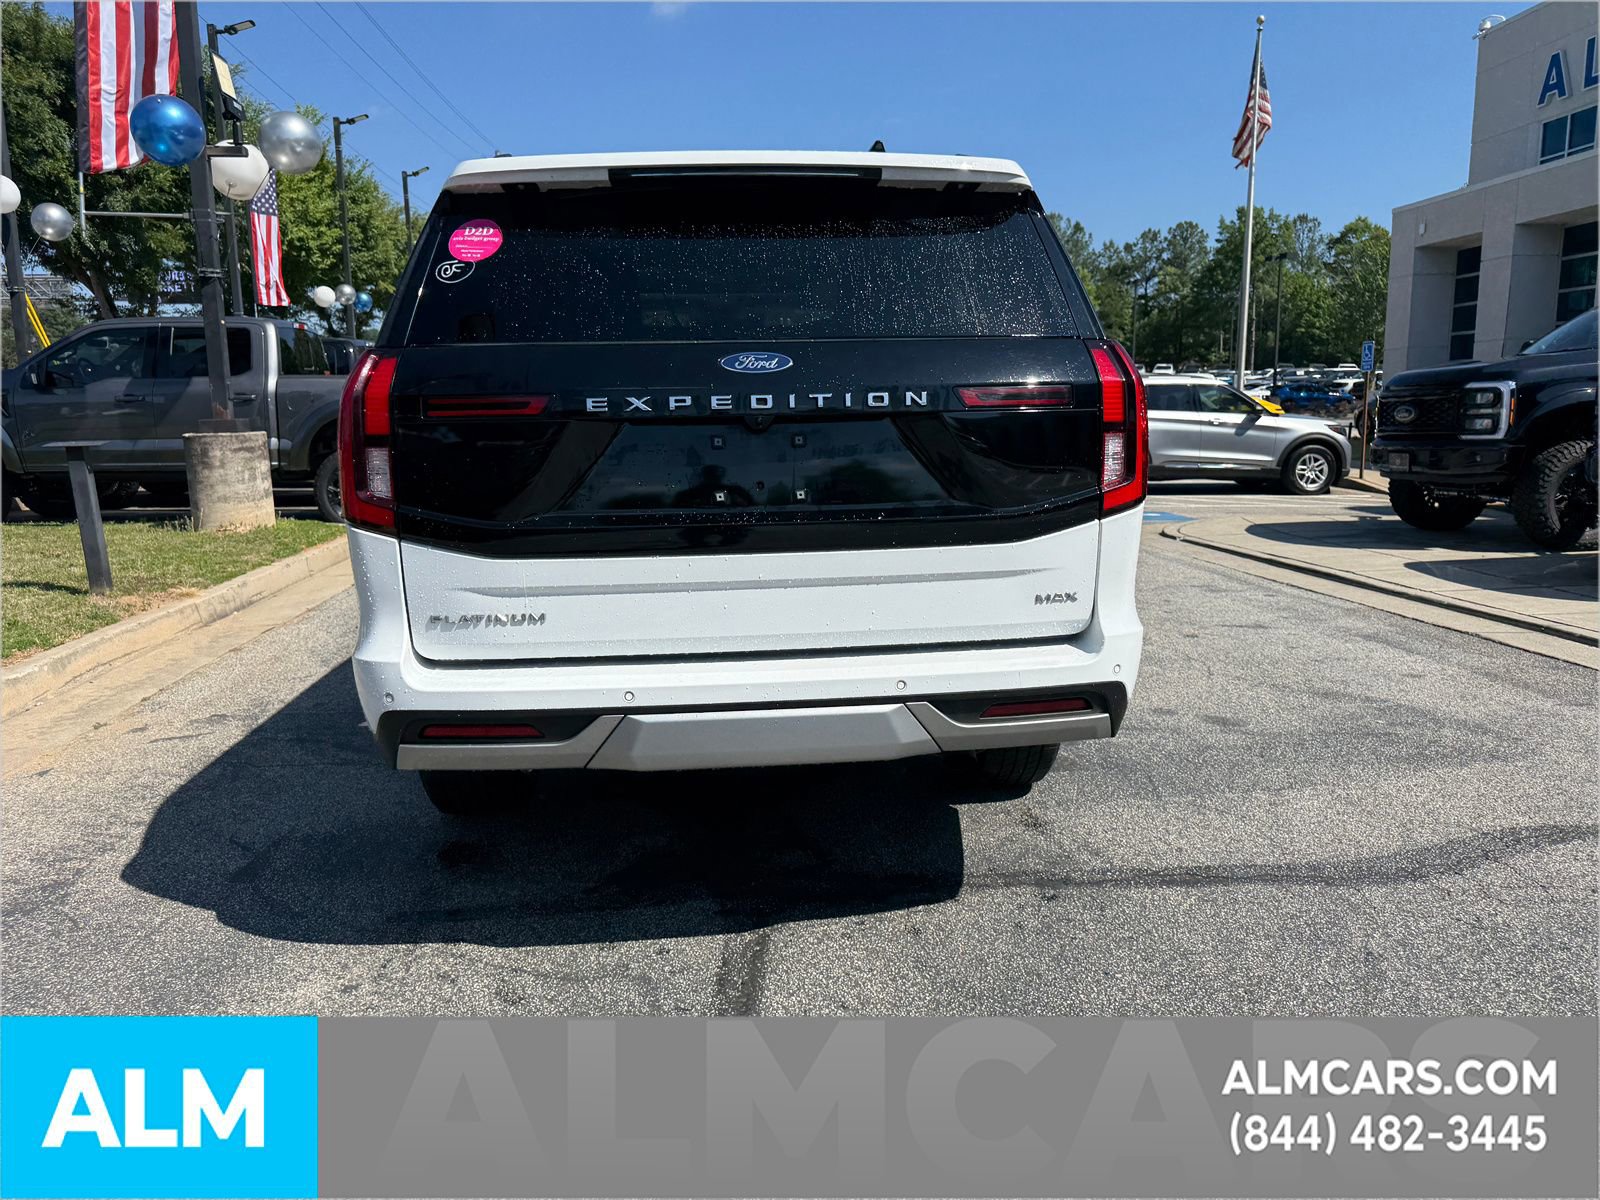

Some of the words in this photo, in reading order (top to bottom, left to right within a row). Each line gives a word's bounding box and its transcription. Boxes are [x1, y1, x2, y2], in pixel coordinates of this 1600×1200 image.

[464, 226, 494, 236] D2D
[735, 354, 779, 369] Ford
[586, 391, 928, 411] EXPEDITION
[1034, 591, 1078, 605] MAX
[425, 612, 547, 632] PLATINUM
